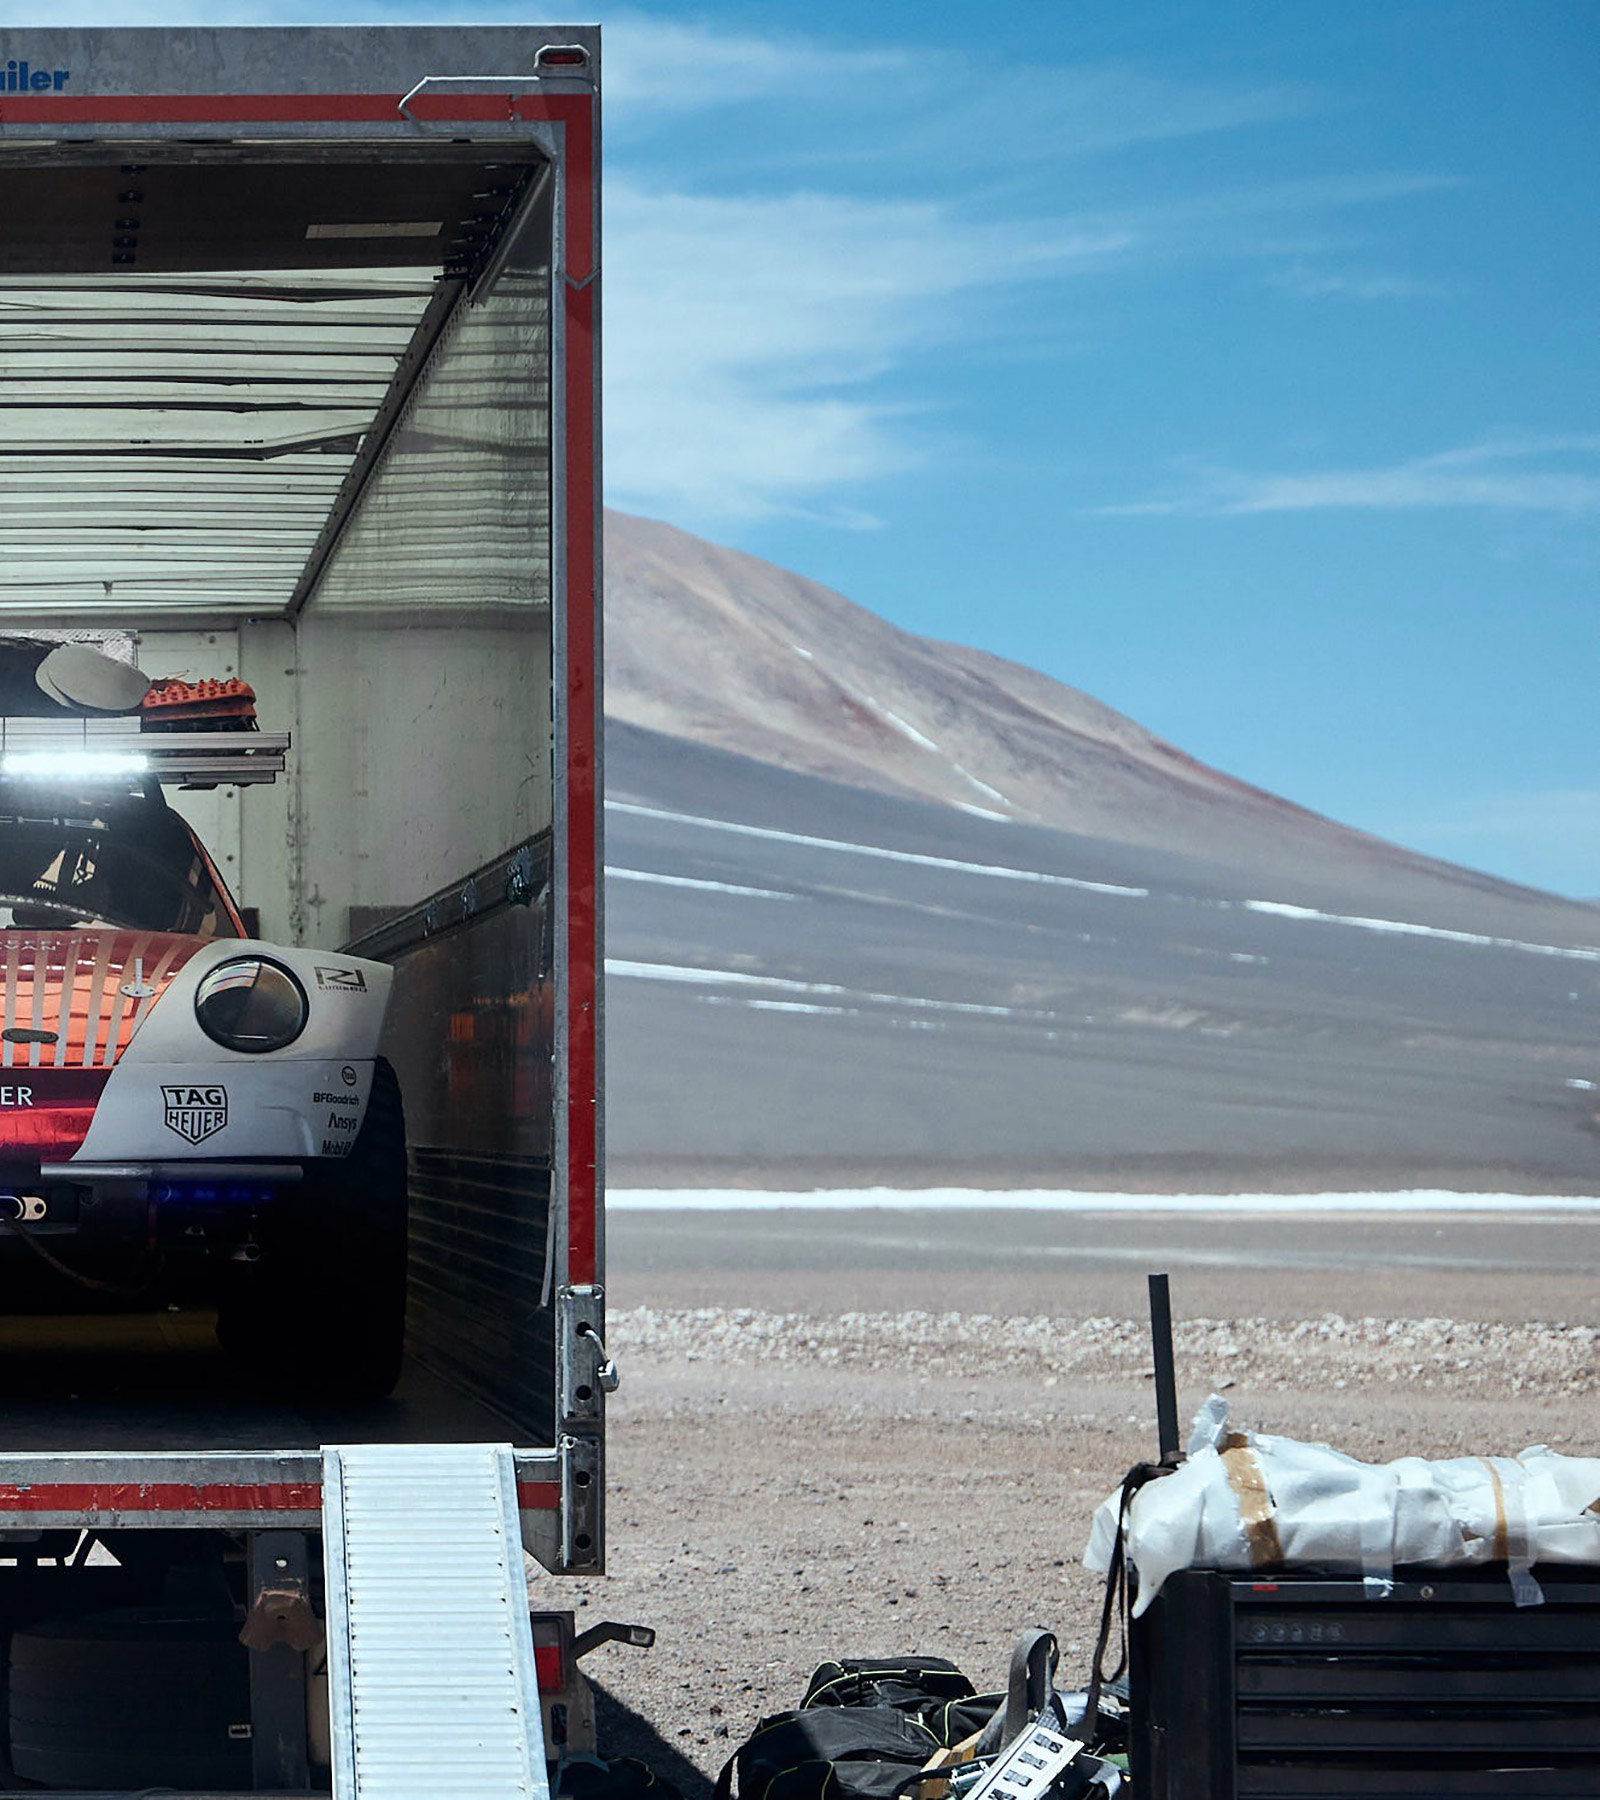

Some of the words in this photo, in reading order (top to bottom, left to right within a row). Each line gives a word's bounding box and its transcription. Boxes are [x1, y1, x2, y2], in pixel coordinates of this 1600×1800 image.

[167, 1089, 222, 1106] TAG
[169, 1111, 223, 1140] HEUER
[328, 1112, 358, 1133] Ansys
